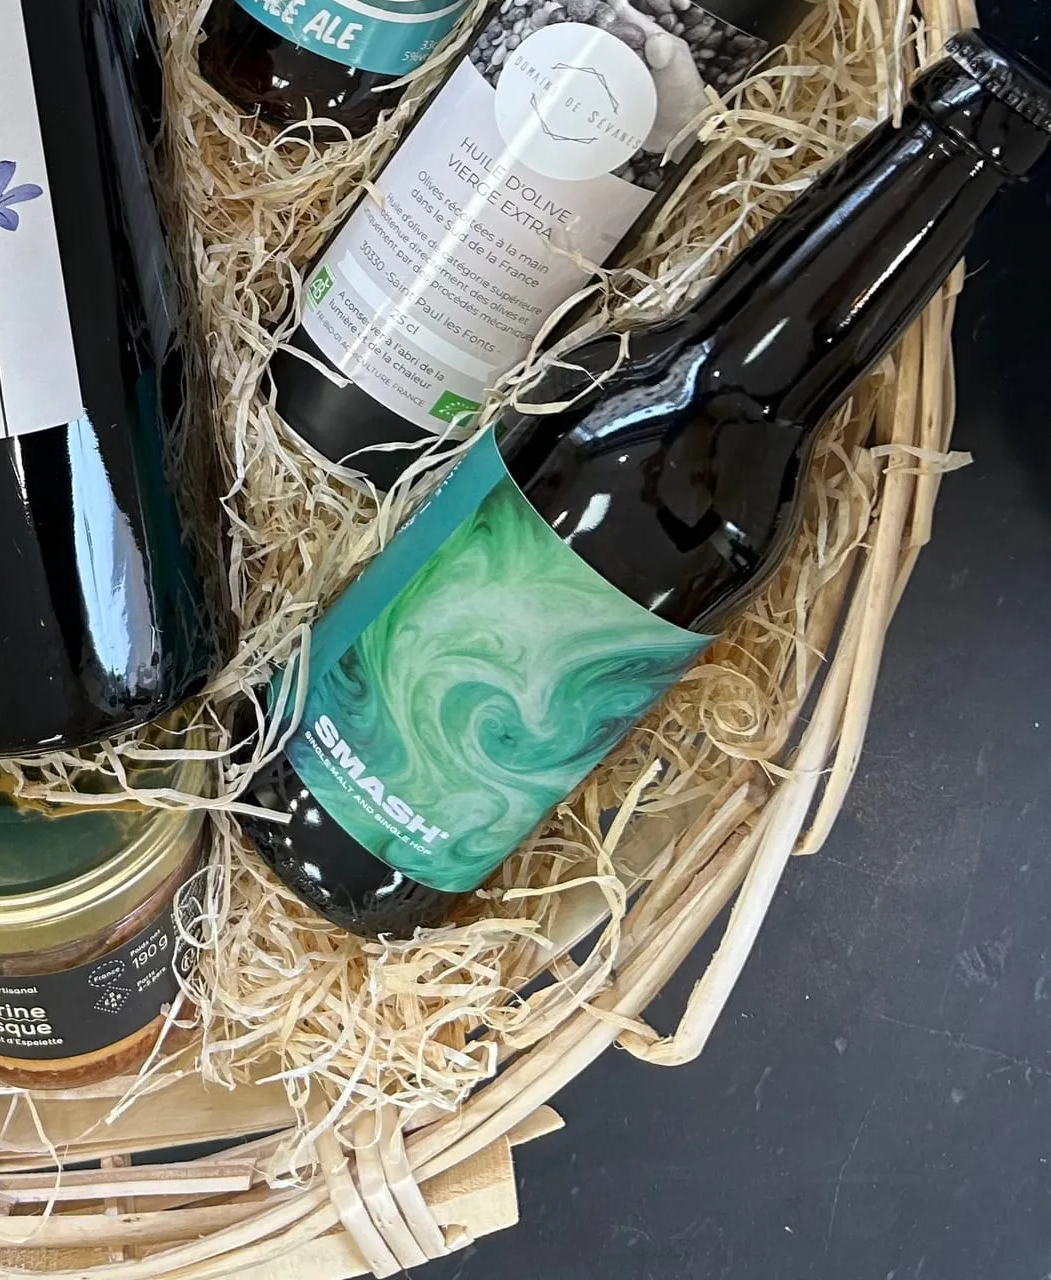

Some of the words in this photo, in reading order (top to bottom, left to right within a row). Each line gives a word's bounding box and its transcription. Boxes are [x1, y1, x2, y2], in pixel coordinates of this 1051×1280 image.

[302, 9, 364, 51] ALE
[565, 97, 582, 113] DE
[417, 170, 448, 202] Olives
[444, 199, 496, 243] récoltées
[506, 243, 518, 257] la
[518, 252, 550, 274] main
[448, 153, 502, 206] VIERGE
[500, 200, 552, 241] EXTRA
[460, 136, 507, 181] HUILE
[505, 175, 573, 224] D'OLIVE
[380, 208, 410, 245] obtenue
[469, 287, 491, 309] des
[490, 300, 519, 323] olives
[401, 213, 432, 241] d'olive
[442, 250, 491, 290] catégorie
[491, 284, 544, 316] supérieure
[411, 187, 435, 214] dans
[433, 210, 445, 224] le
[444, 219, 469, 244] Sud
[468, 239, 486, 257] de
[485, 250, 498, 265] la
[498, 260, 540, 289] France
[359, 239, 386, 272] 30330
[414, 296, 444, 322] Paul
[443, 316, 463, 336] les
[462, 329, 496, 354] Fonts
[396, 249, 418, 268] par
[428, 279, 480, 317] procédés
[328, 298, 358, 334] lumière
[392, 359, 433, 391] chaleur
[391, 342, 421, 367] l'abri
[419, 360, 436, 376] de
[434, 369, 446, 383] la
[406, 321, 421, 336] cl
[390, 383, 427, 408] FRANCE
[304, 730, 331, 769] SINGLE
[330, 766, 355, 794] MALT
[353, 794, 375, 815] AND
[374, 813, 411, 844] SINGLE
[410, 840, 432, 856] HOP
[132, 943, 157, 969] 190
[6, 1037, 64, 1047] d'Espelette
